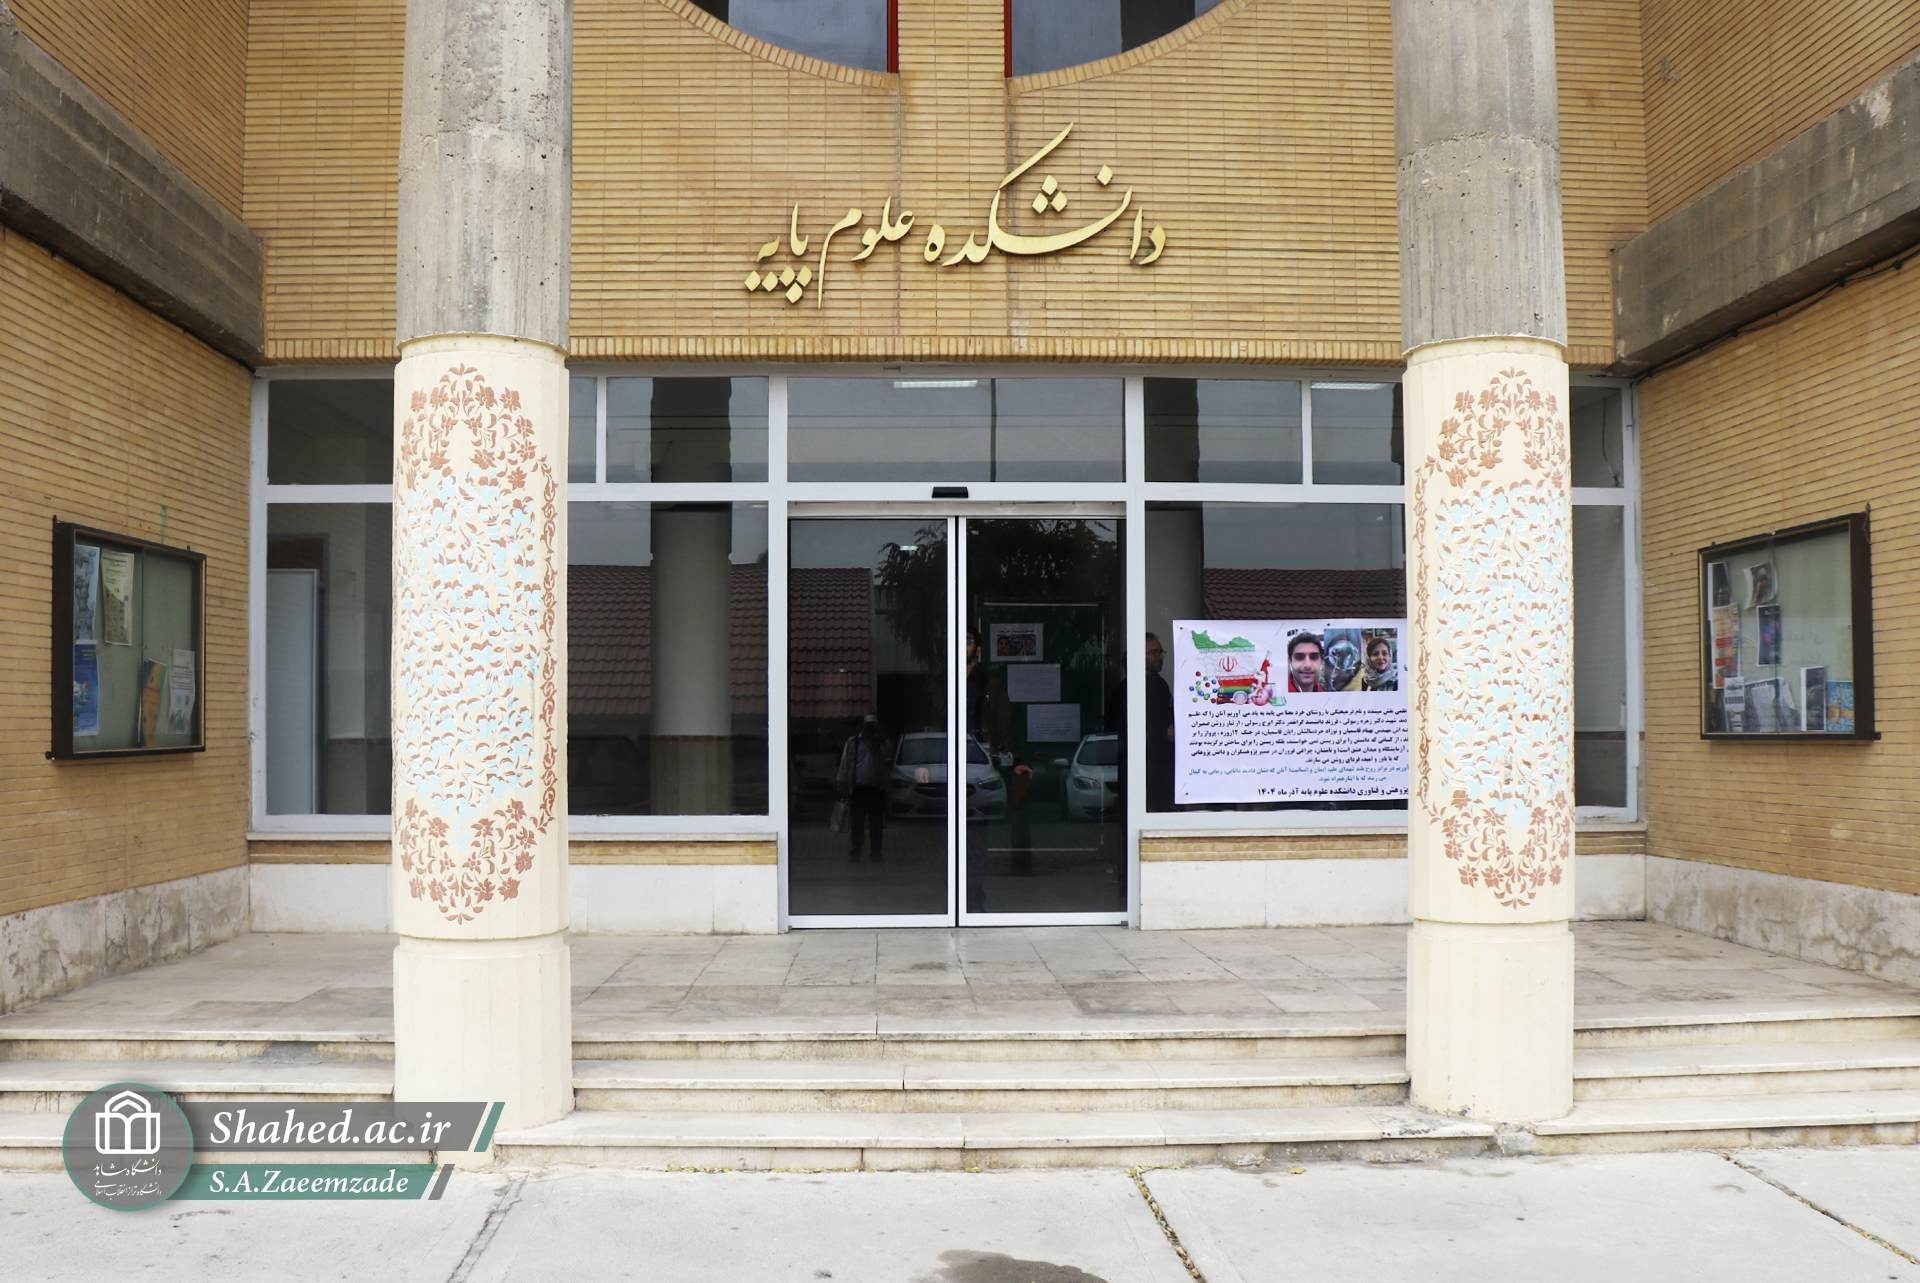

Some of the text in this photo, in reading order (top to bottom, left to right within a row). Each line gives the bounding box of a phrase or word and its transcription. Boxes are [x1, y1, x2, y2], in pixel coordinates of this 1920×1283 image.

[744, 121, 1166, 310] دانشکده علوم پایه
[1301, 788, 1312, 796] پایه
[1314, 788, 1328, 796] علوم
[1357, 786, 1379, 796] فناوری
